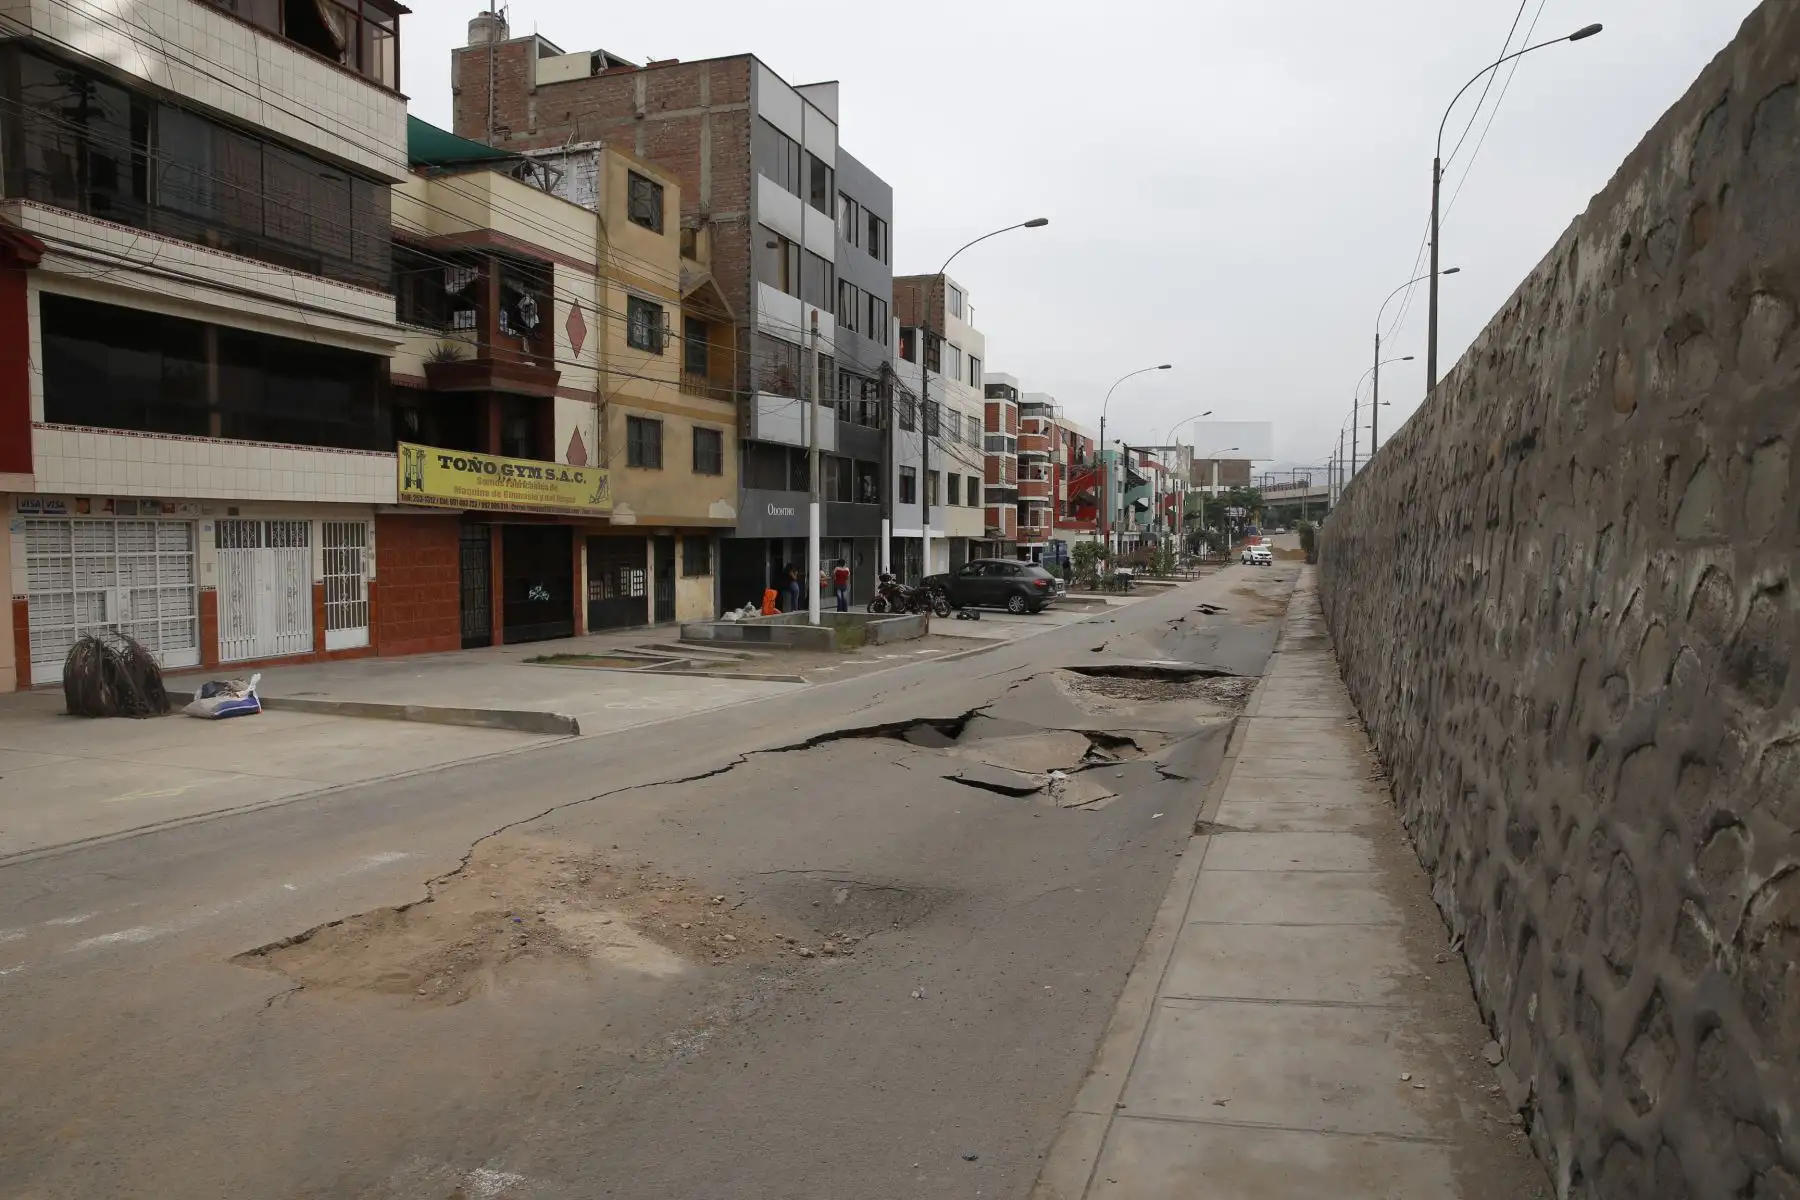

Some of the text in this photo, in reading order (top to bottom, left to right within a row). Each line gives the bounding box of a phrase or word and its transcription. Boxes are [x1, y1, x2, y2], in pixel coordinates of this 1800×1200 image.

[437, 455, 587, 484] TOÑO GYM S.A.C.
